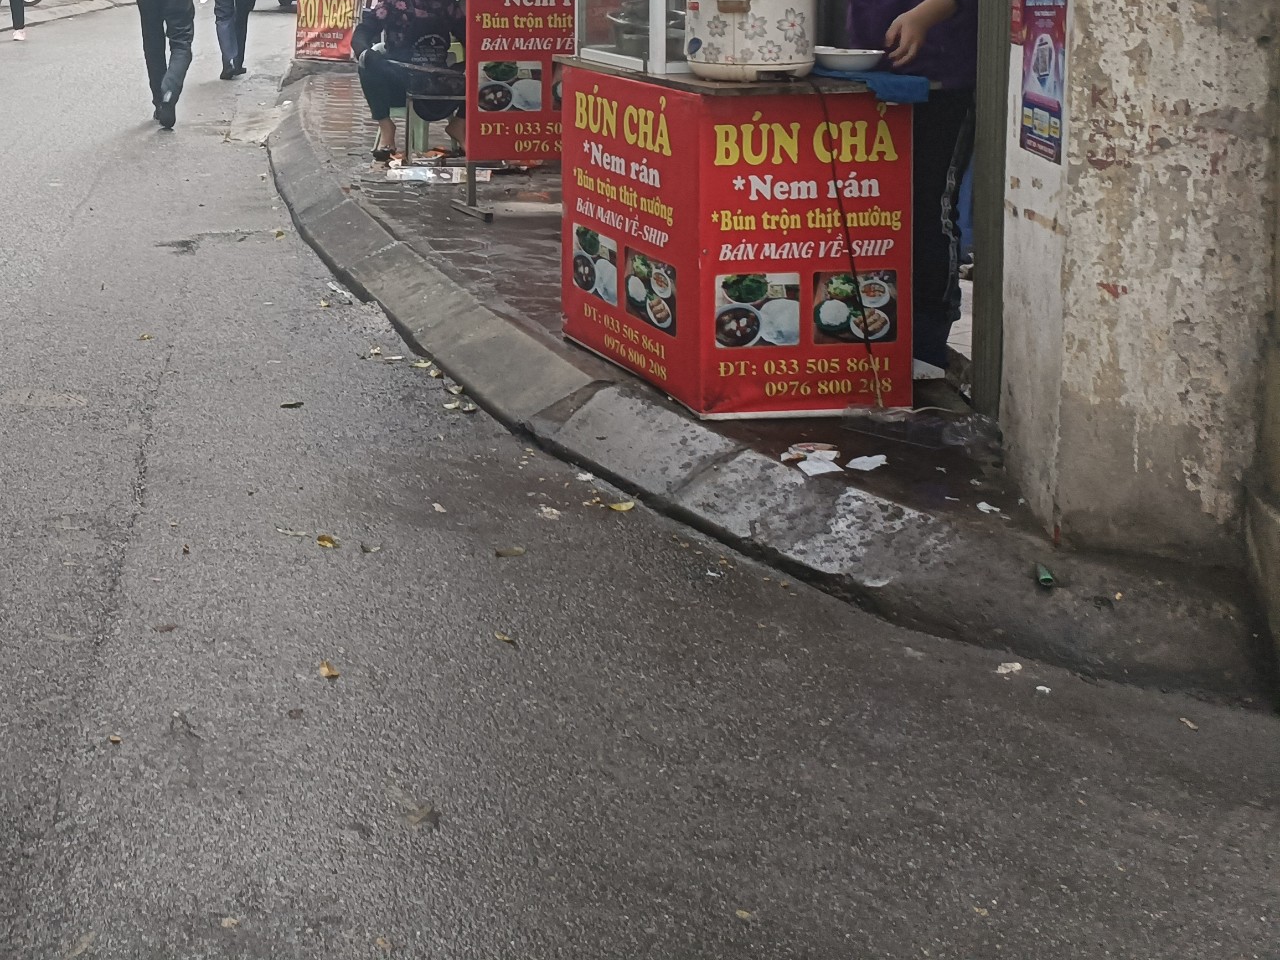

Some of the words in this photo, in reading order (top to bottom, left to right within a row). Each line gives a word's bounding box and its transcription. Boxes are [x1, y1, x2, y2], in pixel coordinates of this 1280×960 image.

[513, 12, 544, 33] trộn
[547, 12, 574, 33] thịt
[481, 34, 511, 51] BÁN
[512, 37, 554, 51] MANG
[480, 122, 510, 136] ĐT:
[514, 122, 541, 135] 033
[545, 122, 562, 135] 50
[575, 85, 618, 139] BÚN
[623, 95, 672, 157] CHẢ
[713, 110, 801, 166] BÚN
[813, 102, 898, 164] CHẢ
[514, 140, 550, 153] 0976
[630, 157, 661, 188] rán
[827, 171, 880, 199] rán
[596, 177, 617, 203] trộn
[619, 186, 638, 212] thịt
[576, 197, 595, 218] BÁN
[595, 205, 623, 230] MANG
[762, 208, 801, 235] trộn
[806, 208, 841, 234] thịt
[719, 238, 758, 262] BÁN
[759, 241, 815, 260] MANG
[583, 303, 602, 324] ĐT:
[603, 314, 620, 334] 033
[622, 324, 639, 347] 505
[641, 333, 666, 360] 8641
[604, 333, 626, 359] 0976
[627, 346, 646, 371] 800
[648, 357, 667, 381] 208
[718, 361, 758, 378] ĐT:
[763, 358, 799, 376] 033
[806, 357, 841, 374] 505
[764, 381, 812, 398] 0976
[817, 379, 852, 395] 800
